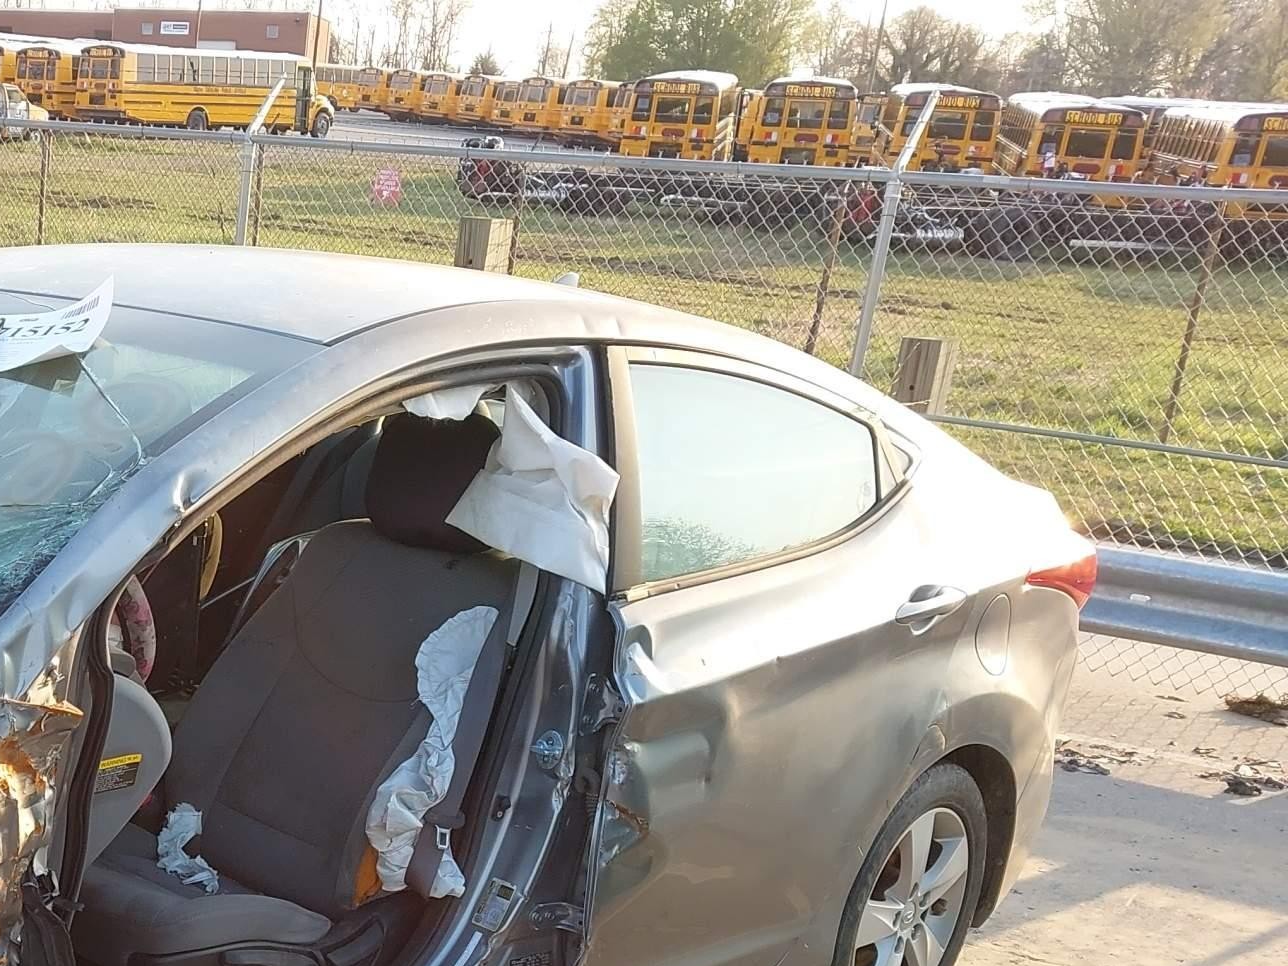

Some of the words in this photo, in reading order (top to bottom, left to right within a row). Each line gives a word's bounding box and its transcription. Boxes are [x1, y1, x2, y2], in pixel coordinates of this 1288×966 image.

[654, 82, 686, 94] SCHOOL
[687, 83, 700, 95] BUS
[786, 85, 821, 97] SCHOOL
[823, 86, 836, 97] BUS
[966, 96, 980, 108] BUS
[1065, 111, 1106, 123] SCHOOL
[1108, 112, 1123, 125] BUS
